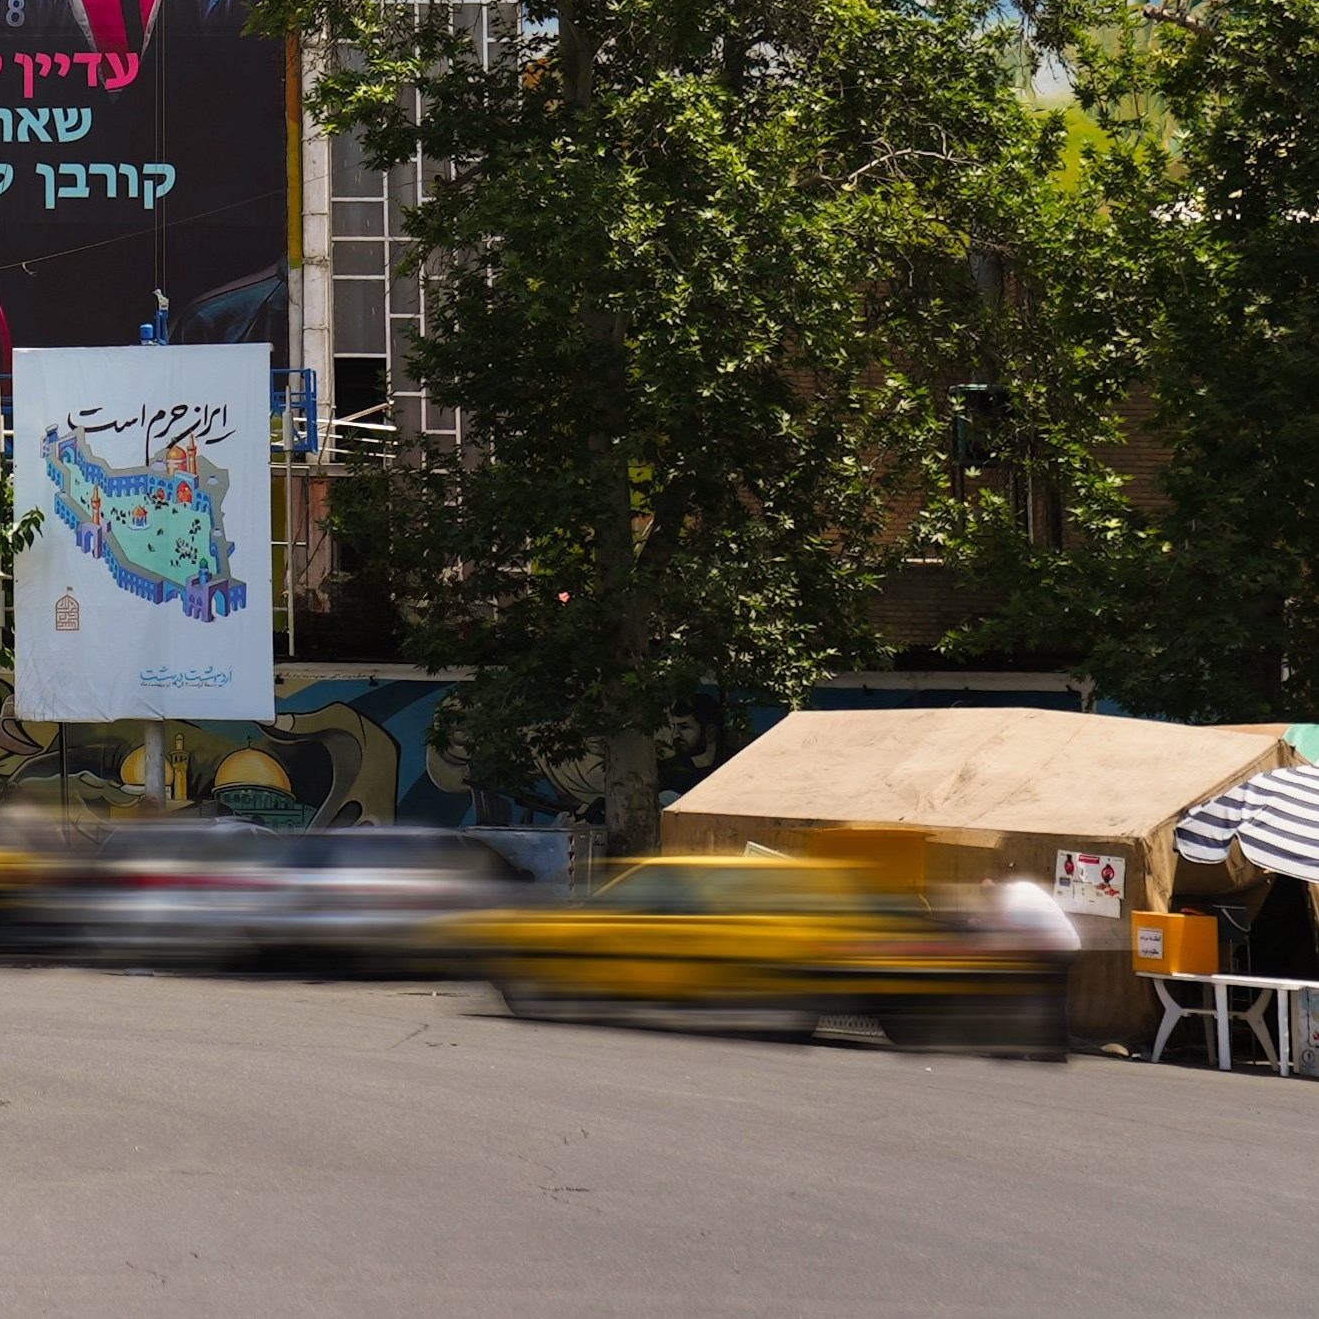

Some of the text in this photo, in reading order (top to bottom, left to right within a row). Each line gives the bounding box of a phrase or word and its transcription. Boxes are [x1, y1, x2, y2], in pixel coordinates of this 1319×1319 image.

[14, 52, 140, 98] עדיין
[35, 163, 177, 210] קורבן
[67, 404, 146, 433] است
[145, 404, 189, 467] حرم
